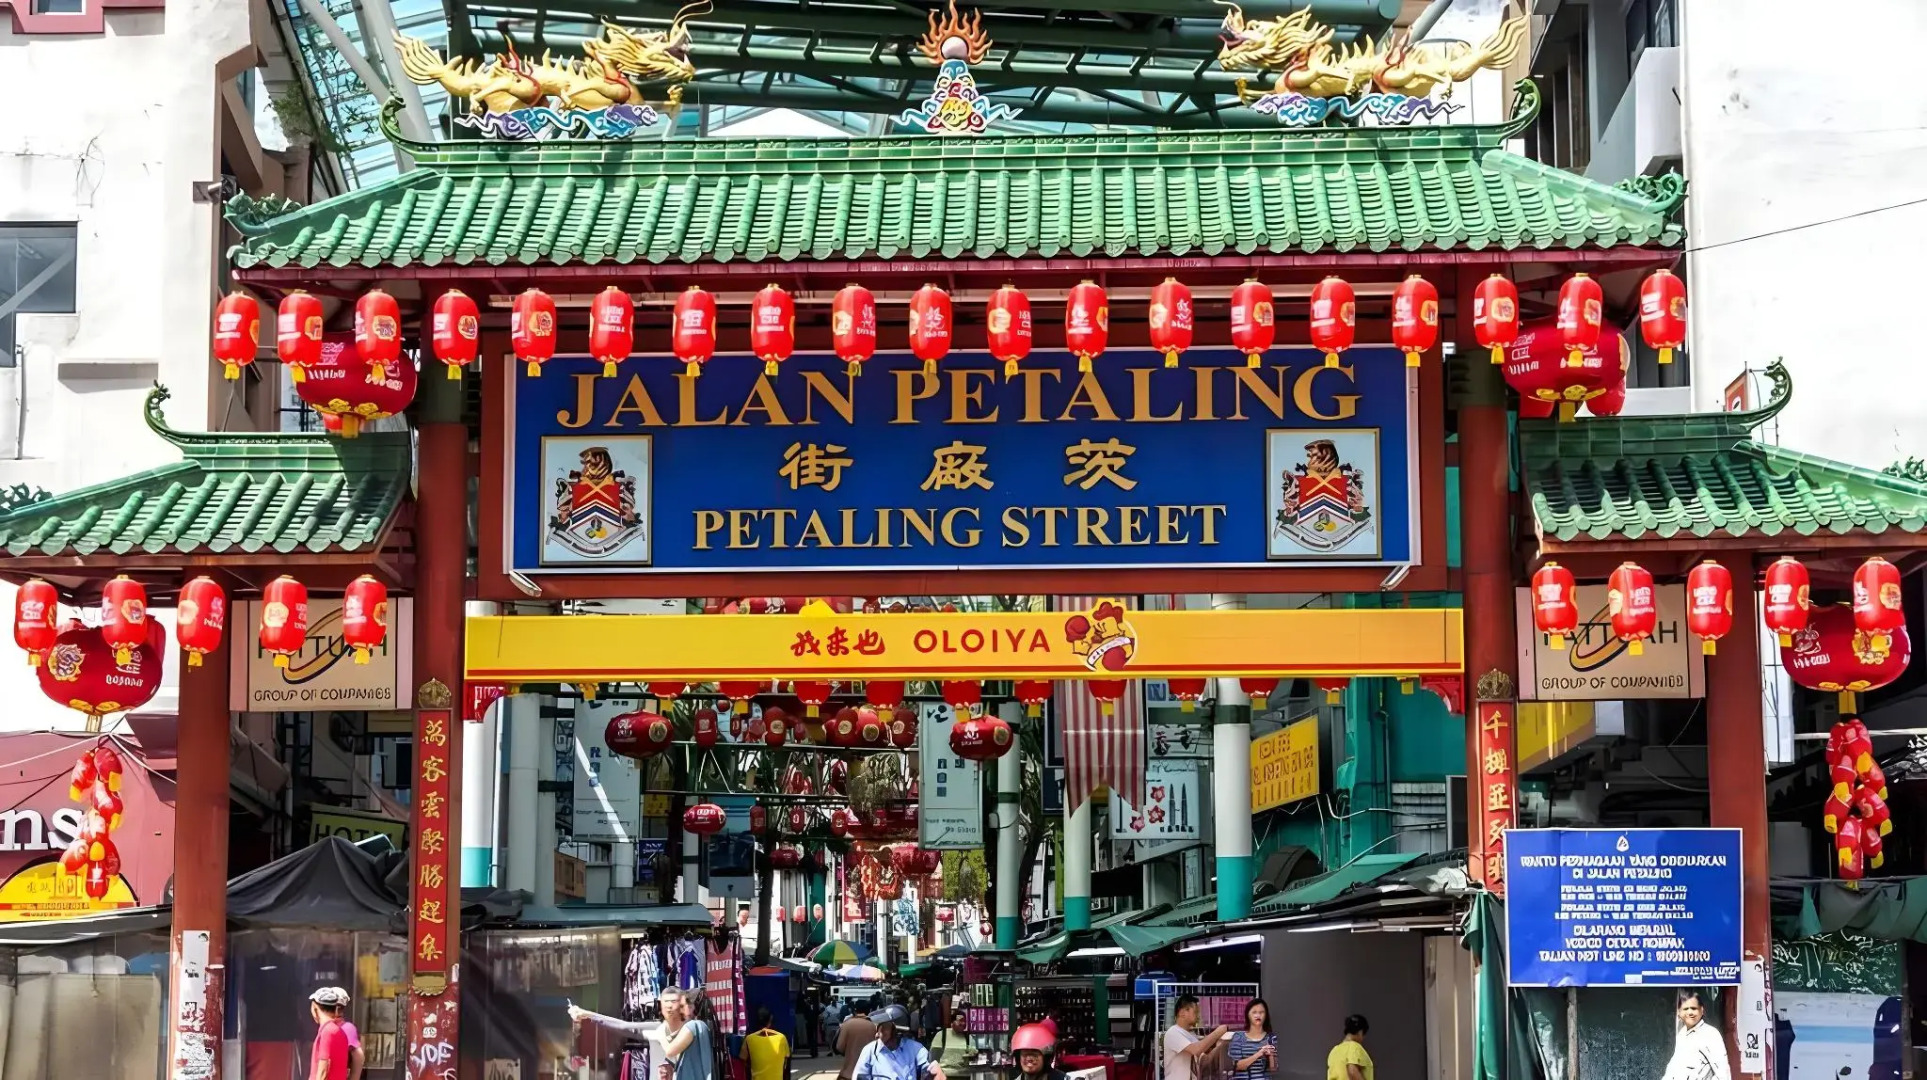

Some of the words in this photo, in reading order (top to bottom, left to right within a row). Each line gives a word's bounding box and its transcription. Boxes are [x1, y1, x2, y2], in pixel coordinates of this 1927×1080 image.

[557, 370, 855, 428] JALAN
[888, 364, 1363, 425] PETALING
[692, 507, 983, 550] PETALING
[1001, 504, 1227, 548] STREET
[914, 627, 1051, 654] OLOIYA
